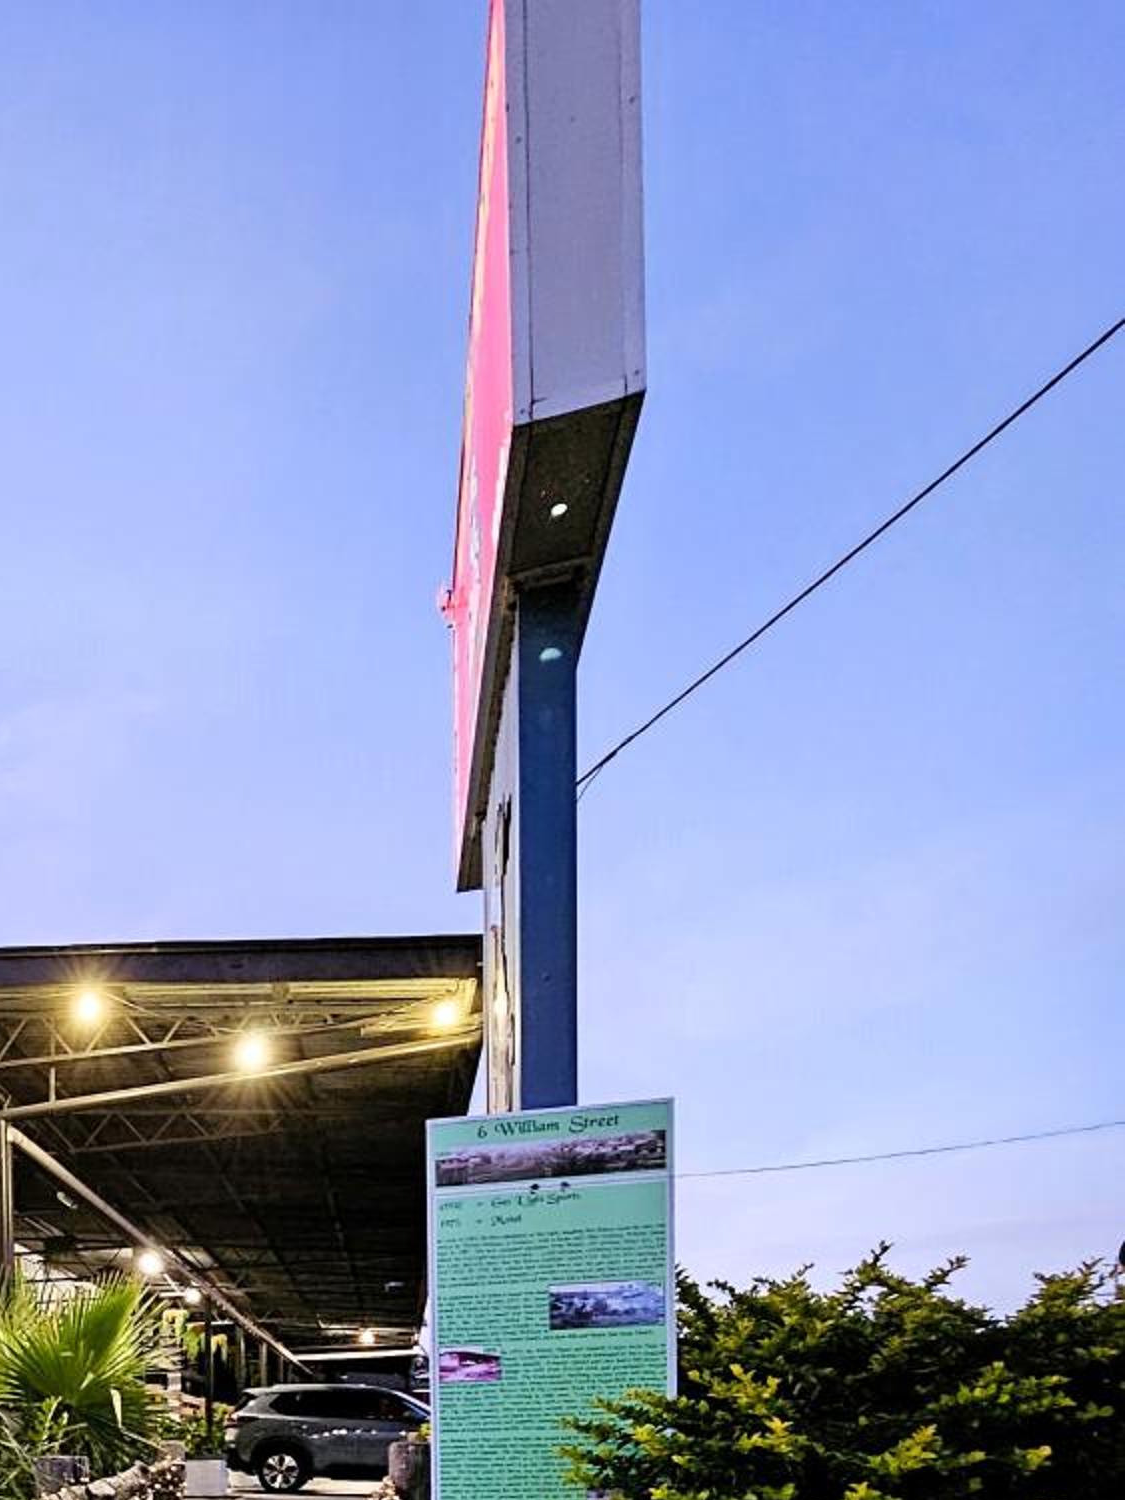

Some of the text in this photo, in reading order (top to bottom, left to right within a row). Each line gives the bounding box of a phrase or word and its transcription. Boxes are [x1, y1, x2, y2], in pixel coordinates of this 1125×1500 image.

[476, 1114, 620, 1139] 6 William Street
